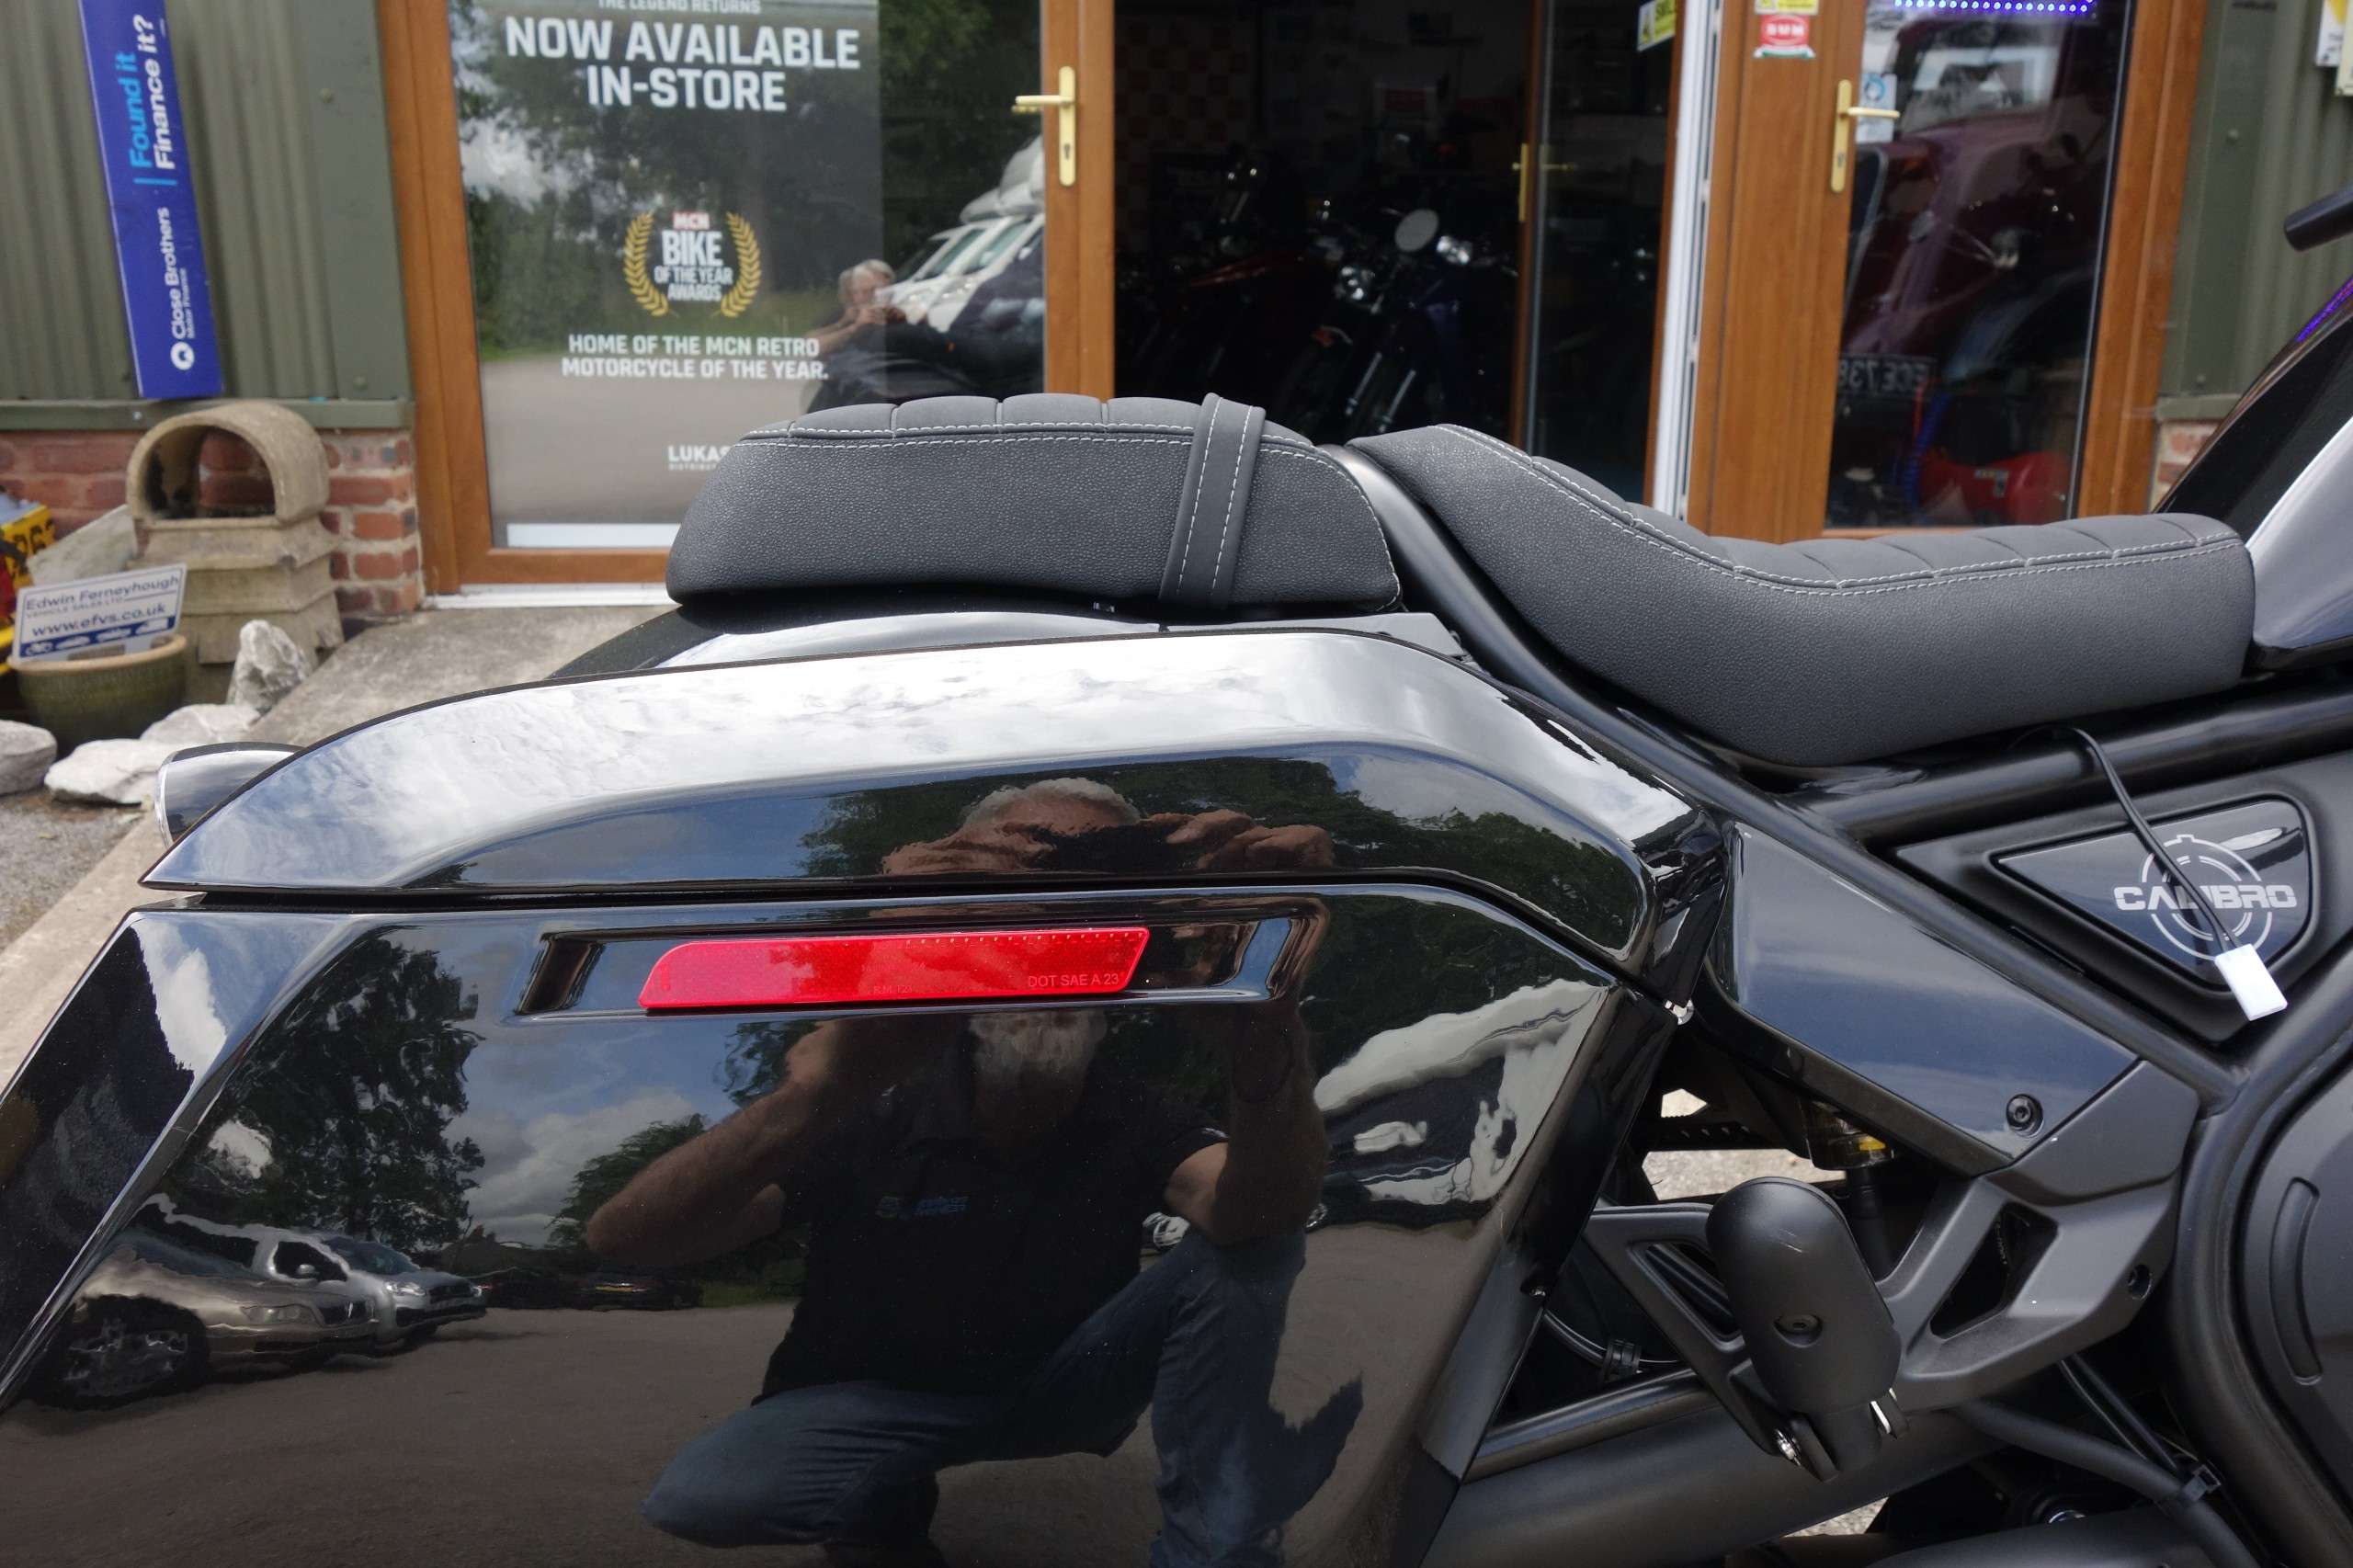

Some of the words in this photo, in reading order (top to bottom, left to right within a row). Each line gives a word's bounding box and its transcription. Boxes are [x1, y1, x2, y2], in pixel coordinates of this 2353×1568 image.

[598, 0, 626, 9] THE
[629, 0, 689, 11] LEGEND
[691, 0, 761, 14] RETURNS
[132, 14, 158, 53] it?
[505, 16, 614, 61] NOW
[625, 21, 860, 69] AVAILABLE
[115, 51, 138, 73] it
[586, 64, 787, 111] IN-STORE
[117, 76, 153, 168] Found
[144, 59, 176, 170] Finance
[157, 207, 180, 286] Brothers
[662, 230, 723, 266] BIKE
[654, 265, 671, 284] OF
[673, 266, 697, 284] THE
[697, 267, 733, 285] YEAR
[667, 284, 722, 301] AWARDS
[168, 288, 187, 339] Close
[569, 334, 628, 354] HOME
[632, 335, 658, 355] OF
[662, 335, 700, 355] THE
[706, 336, 752, 356] MCN
[757, 337, 820, 357] RETRO
[562, 357, 698, 378] MOTORCYCLE
[700, 359, 727, 379] OF
[730, 359, 767, 379] THE
[771, 360, 829, 380] YEAR.
[26, 592, 74, 610] Edwin
[79, 574, 179, 602] Ferneyhough
[32, 603, 166, 637] www.efvs.co.uk
[1029, 975, 1057, 987] DOT
[1060, 974, 1088, 986] SAE
[1091, 973, 1101, 985] A
[1103, 972, 1119, 985] 23
